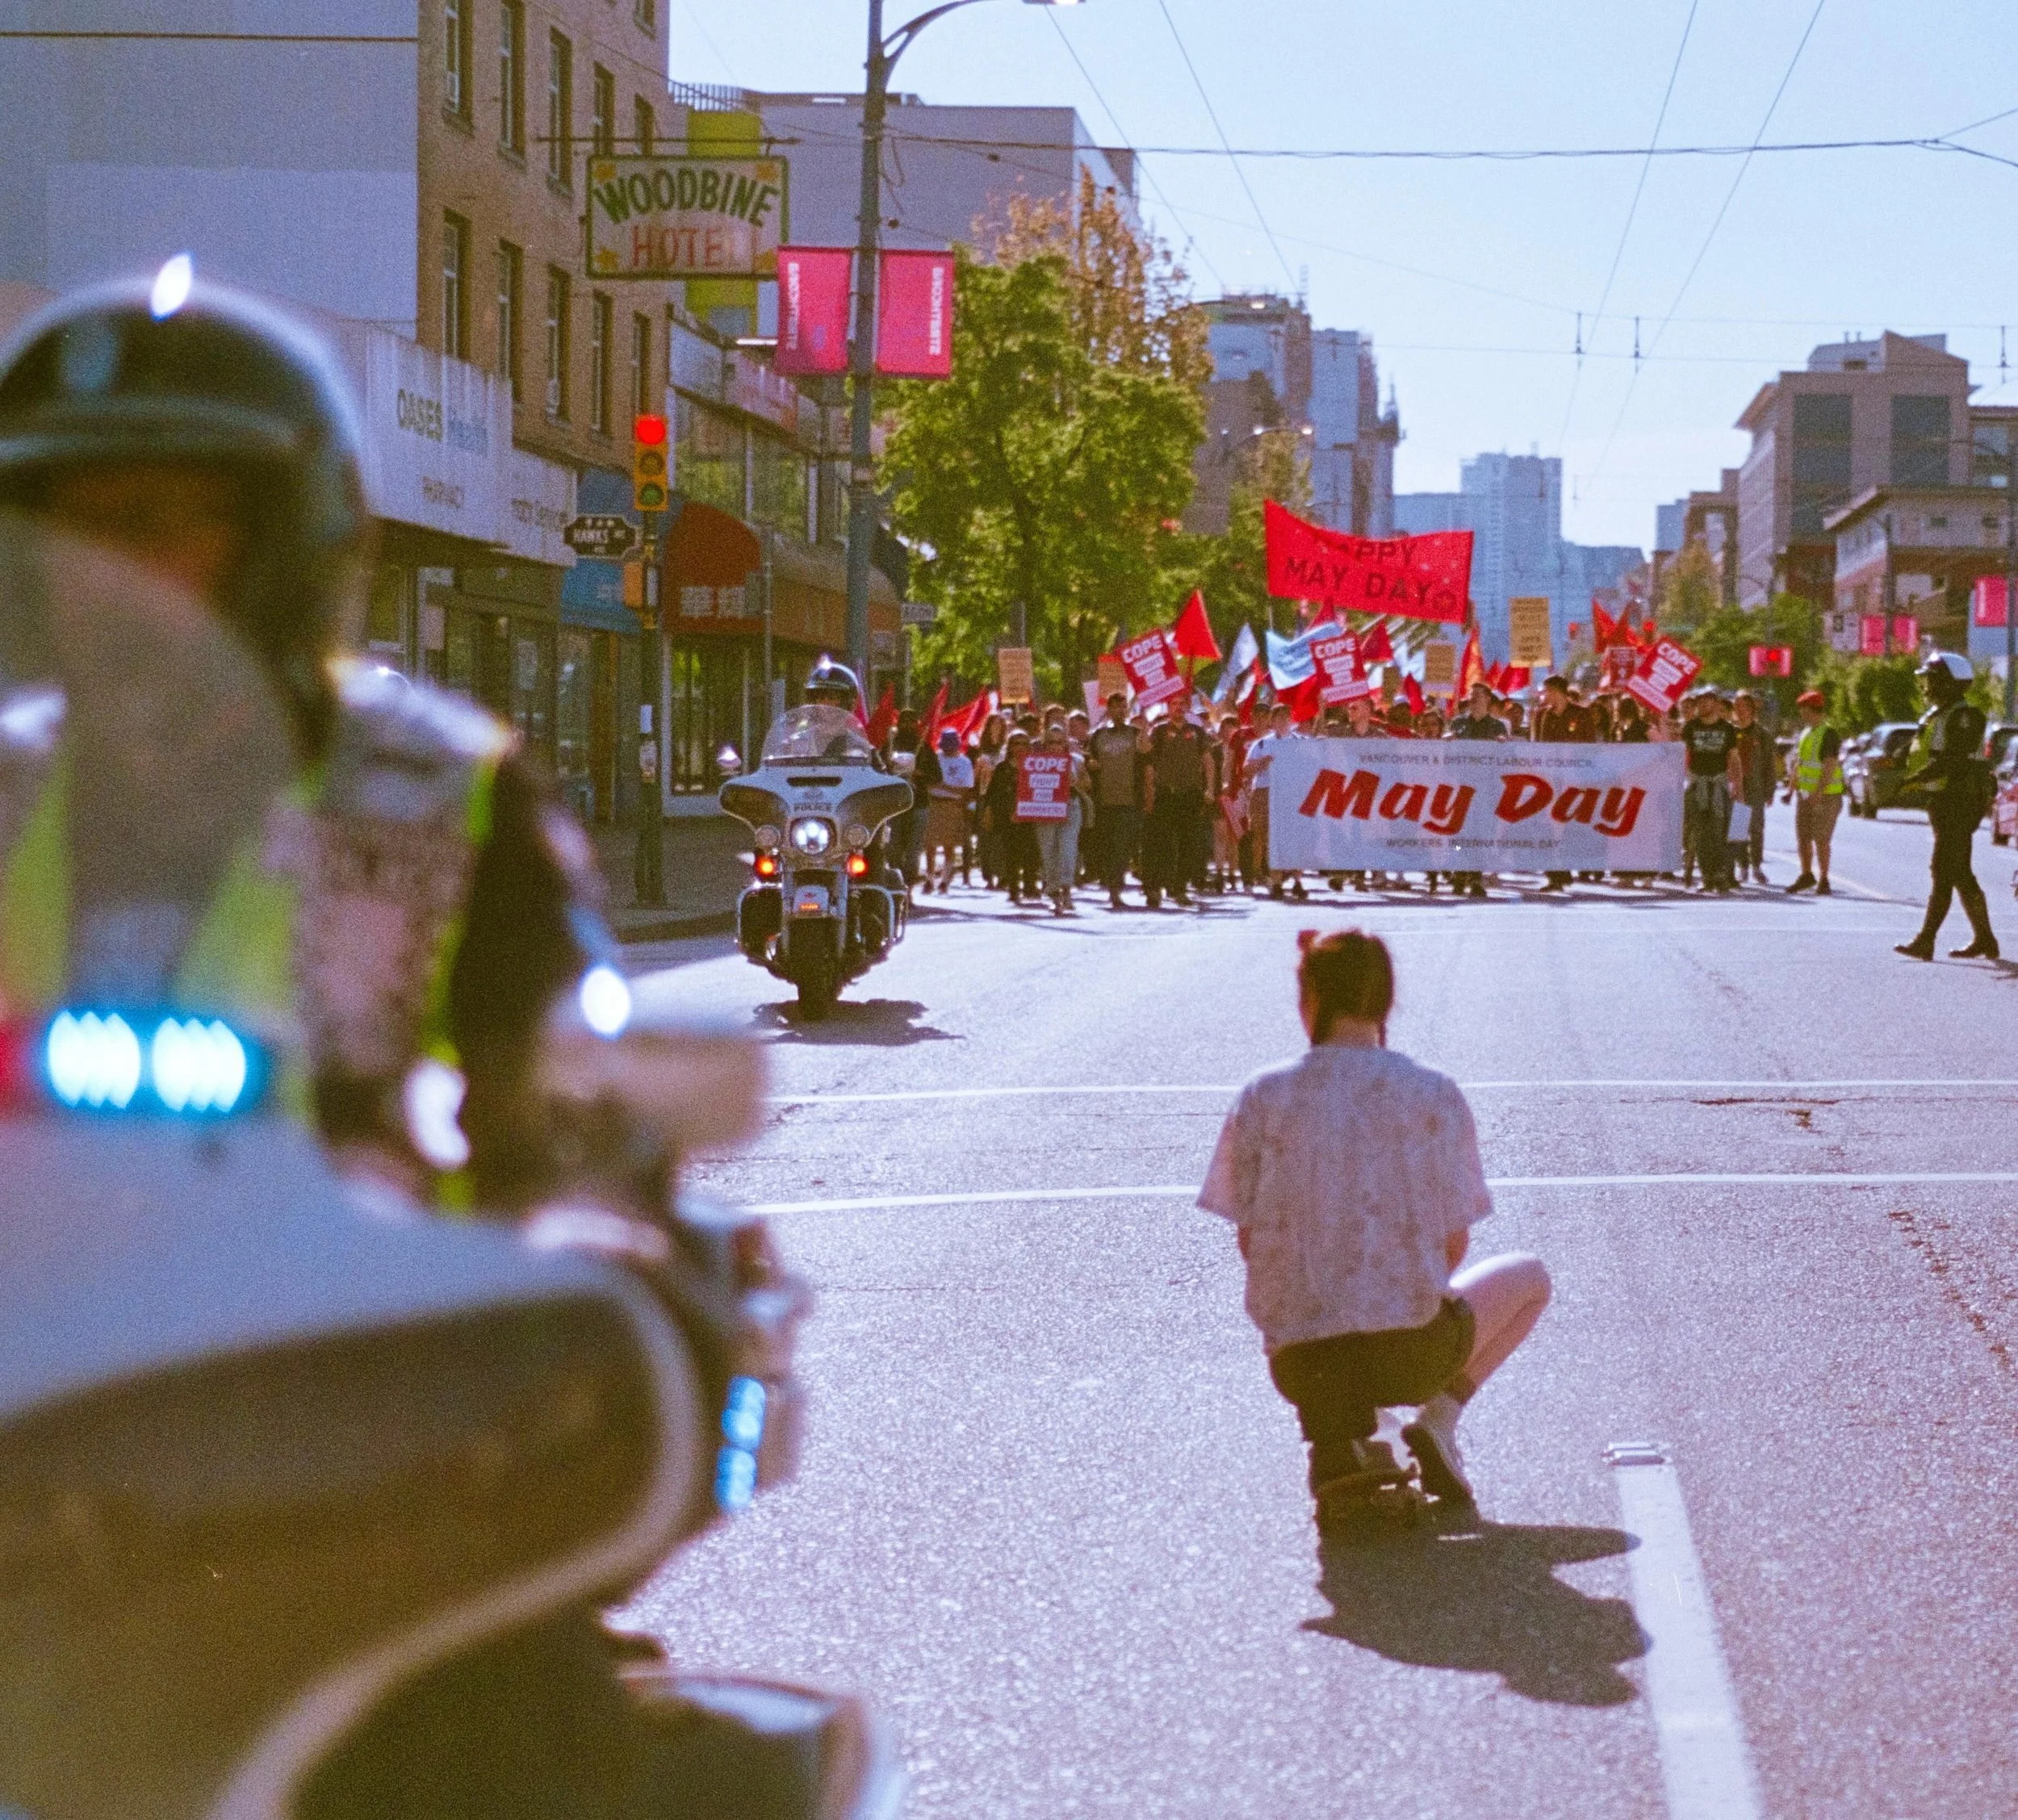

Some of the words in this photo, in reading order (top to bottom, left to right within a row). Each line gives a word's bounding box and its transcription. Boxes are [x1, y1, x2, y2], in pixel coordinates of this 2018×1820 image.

[592, 168, 780, 227] WOODBINE
[632, 225, 741, 268] HOTEL
[1285, 557, 1347, 591] MAY
[1365, 572, 1433, 605] DAY
[1122, 634, 1162, 663] COPE
[1315, 638, 1356, 659] COPE
[1657, 642, 1697, 675] COPE
[1024, 755, 1068, 772] COPE
[1360, 754, 1429, 764] VANCOUVER
[1443, 755, 1494, 766] DISTRICT
[1497, 756, 1542, 767] LABOUR
[1298, 768, 1476, 835] May
[1494, 773, 1647, 838] Day
[1539, 839, 1560, 848] DAY
